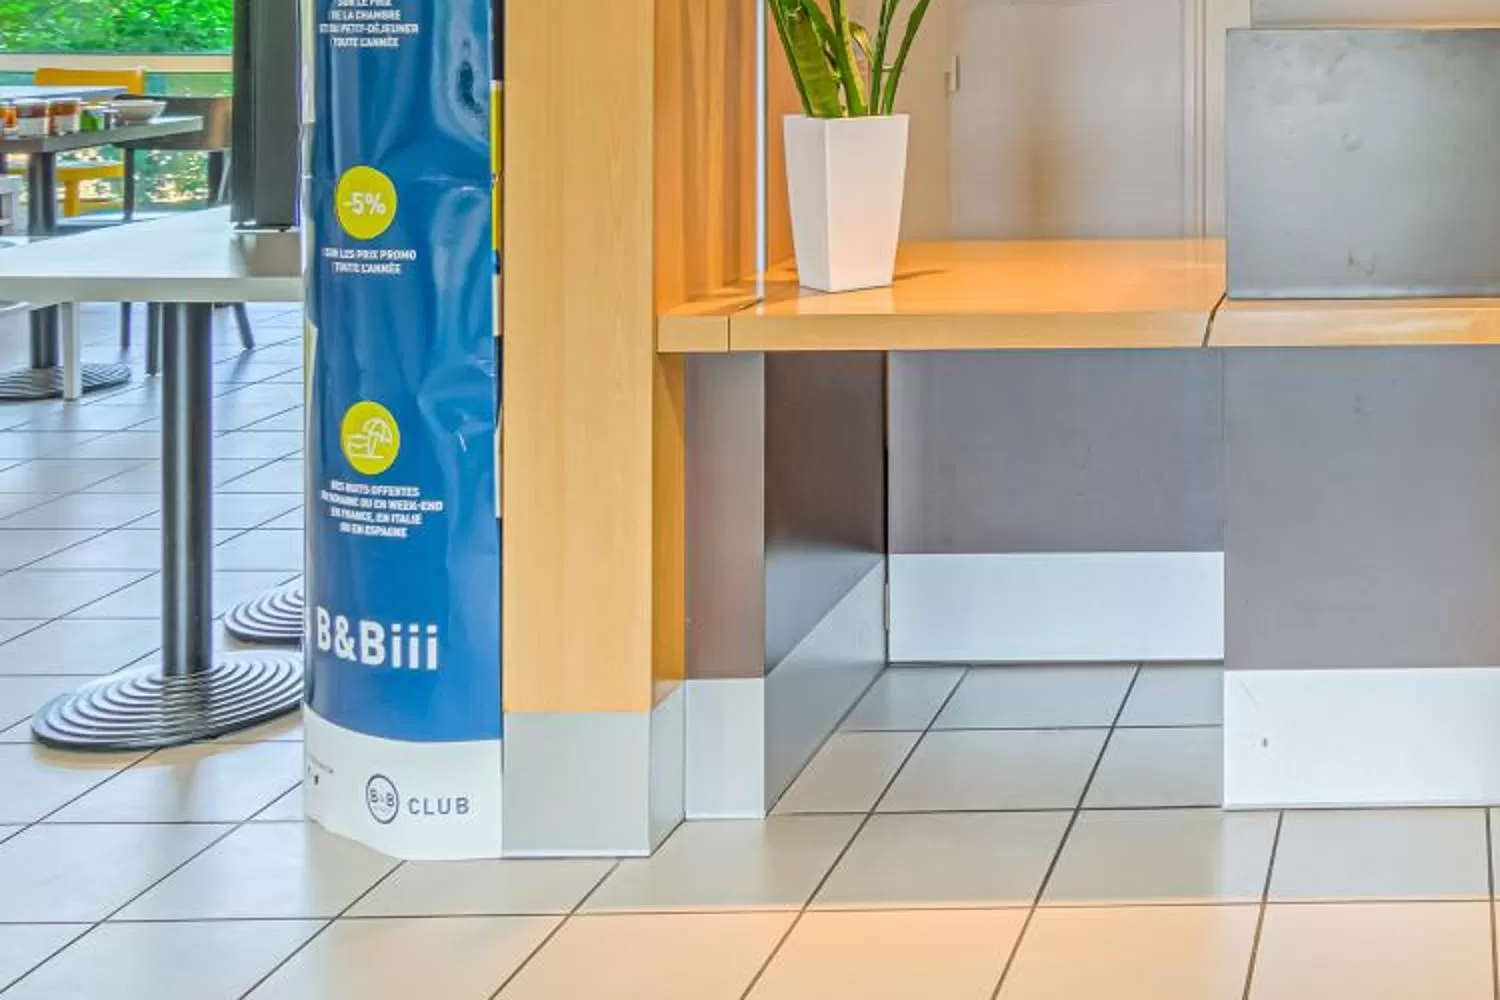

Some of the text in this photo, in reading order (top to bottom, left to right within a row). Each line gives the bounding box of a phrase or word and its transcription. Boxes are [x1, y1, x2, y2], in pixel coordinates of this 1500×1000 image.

[342, 192, 386, 216] -5%
[317, 605, 438, 671] B&Biii
[408, 797, 470, 815] CLUB
